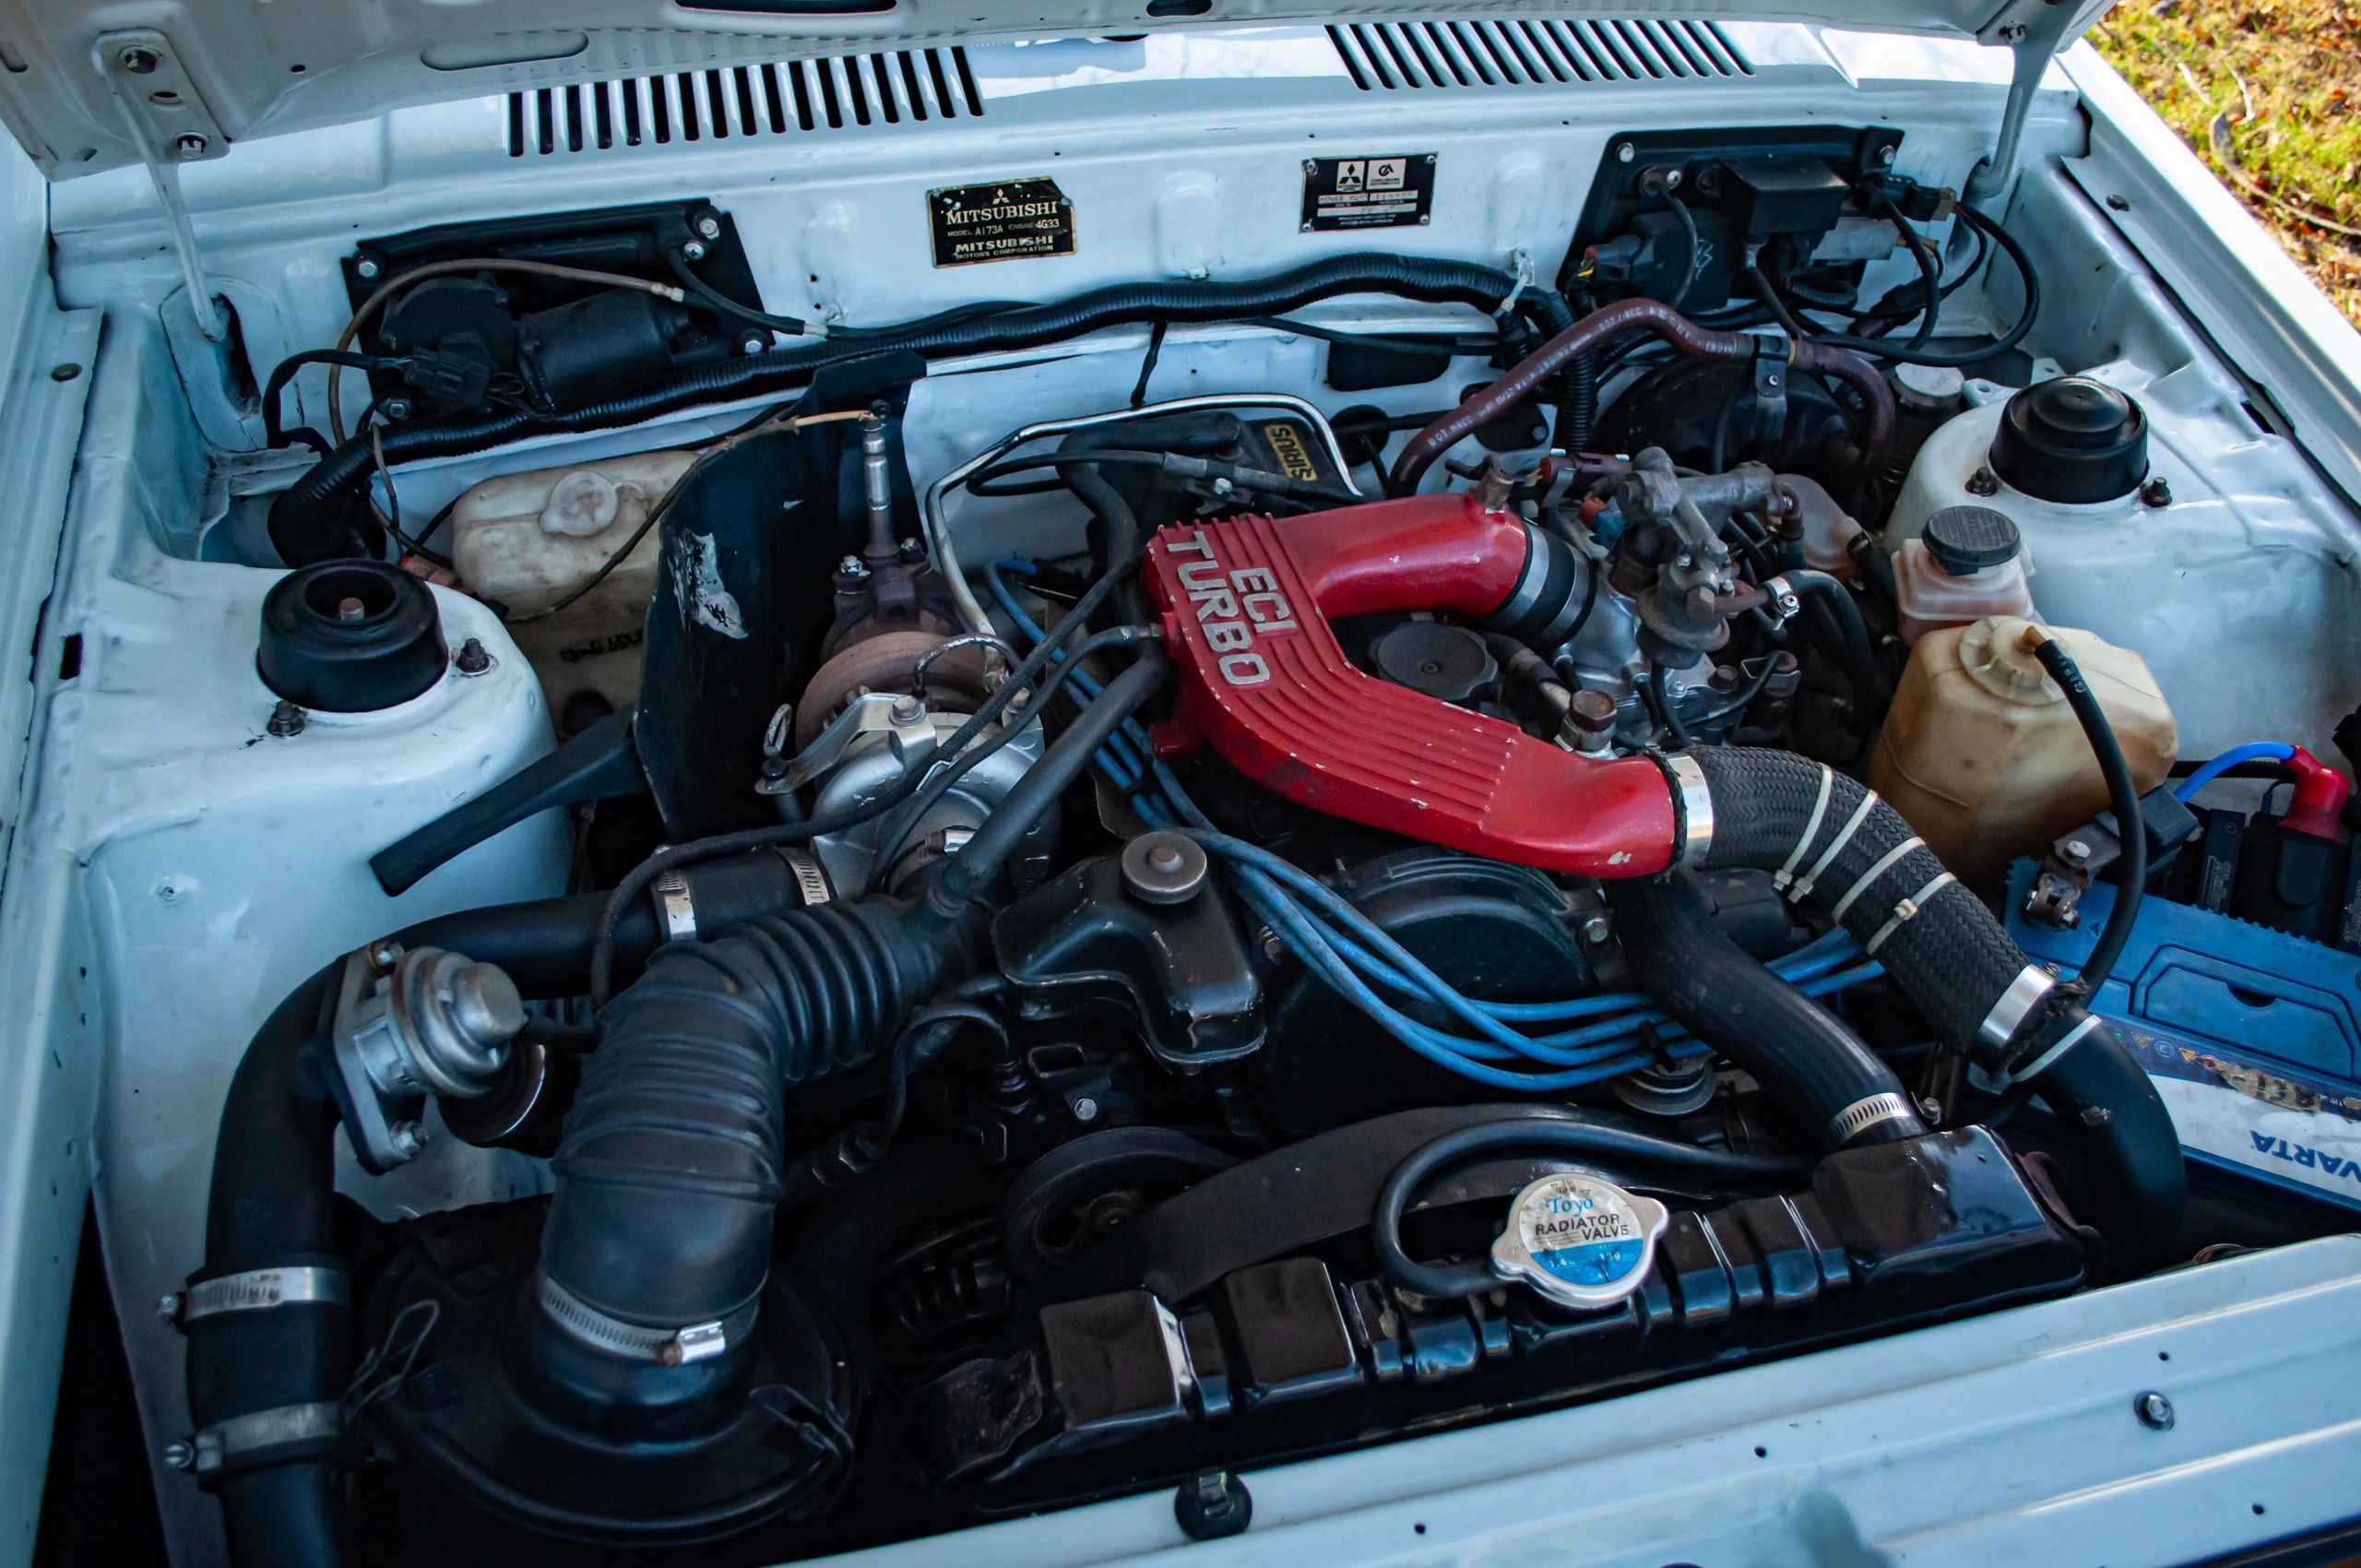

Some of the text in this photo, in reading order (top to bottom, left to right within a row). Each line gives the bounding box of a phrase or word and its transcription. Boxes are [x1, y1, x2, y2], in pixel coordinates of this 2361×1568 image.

[946, 201, 1059, 225] MITSUBISHI
[1035, 218, 1060, 230] 4G33
[955, 235, 1053, 254] MITSUBISHI
[992, 244, 1053, 255] CORPORATION
[1270, 427, 1312, 479] SIRIUS
[1167, 530, 1270, 684] TURBO
[1229, 567, 1297, 634] ECI
[2249, 1130, 2361, 1183] VARTA
[1546, 1195, 1594, 1217] Toyo
[1535, 1213, 1620, 1236] RADIATOR
[1582, 1224, 1629, 1241] VALVE
